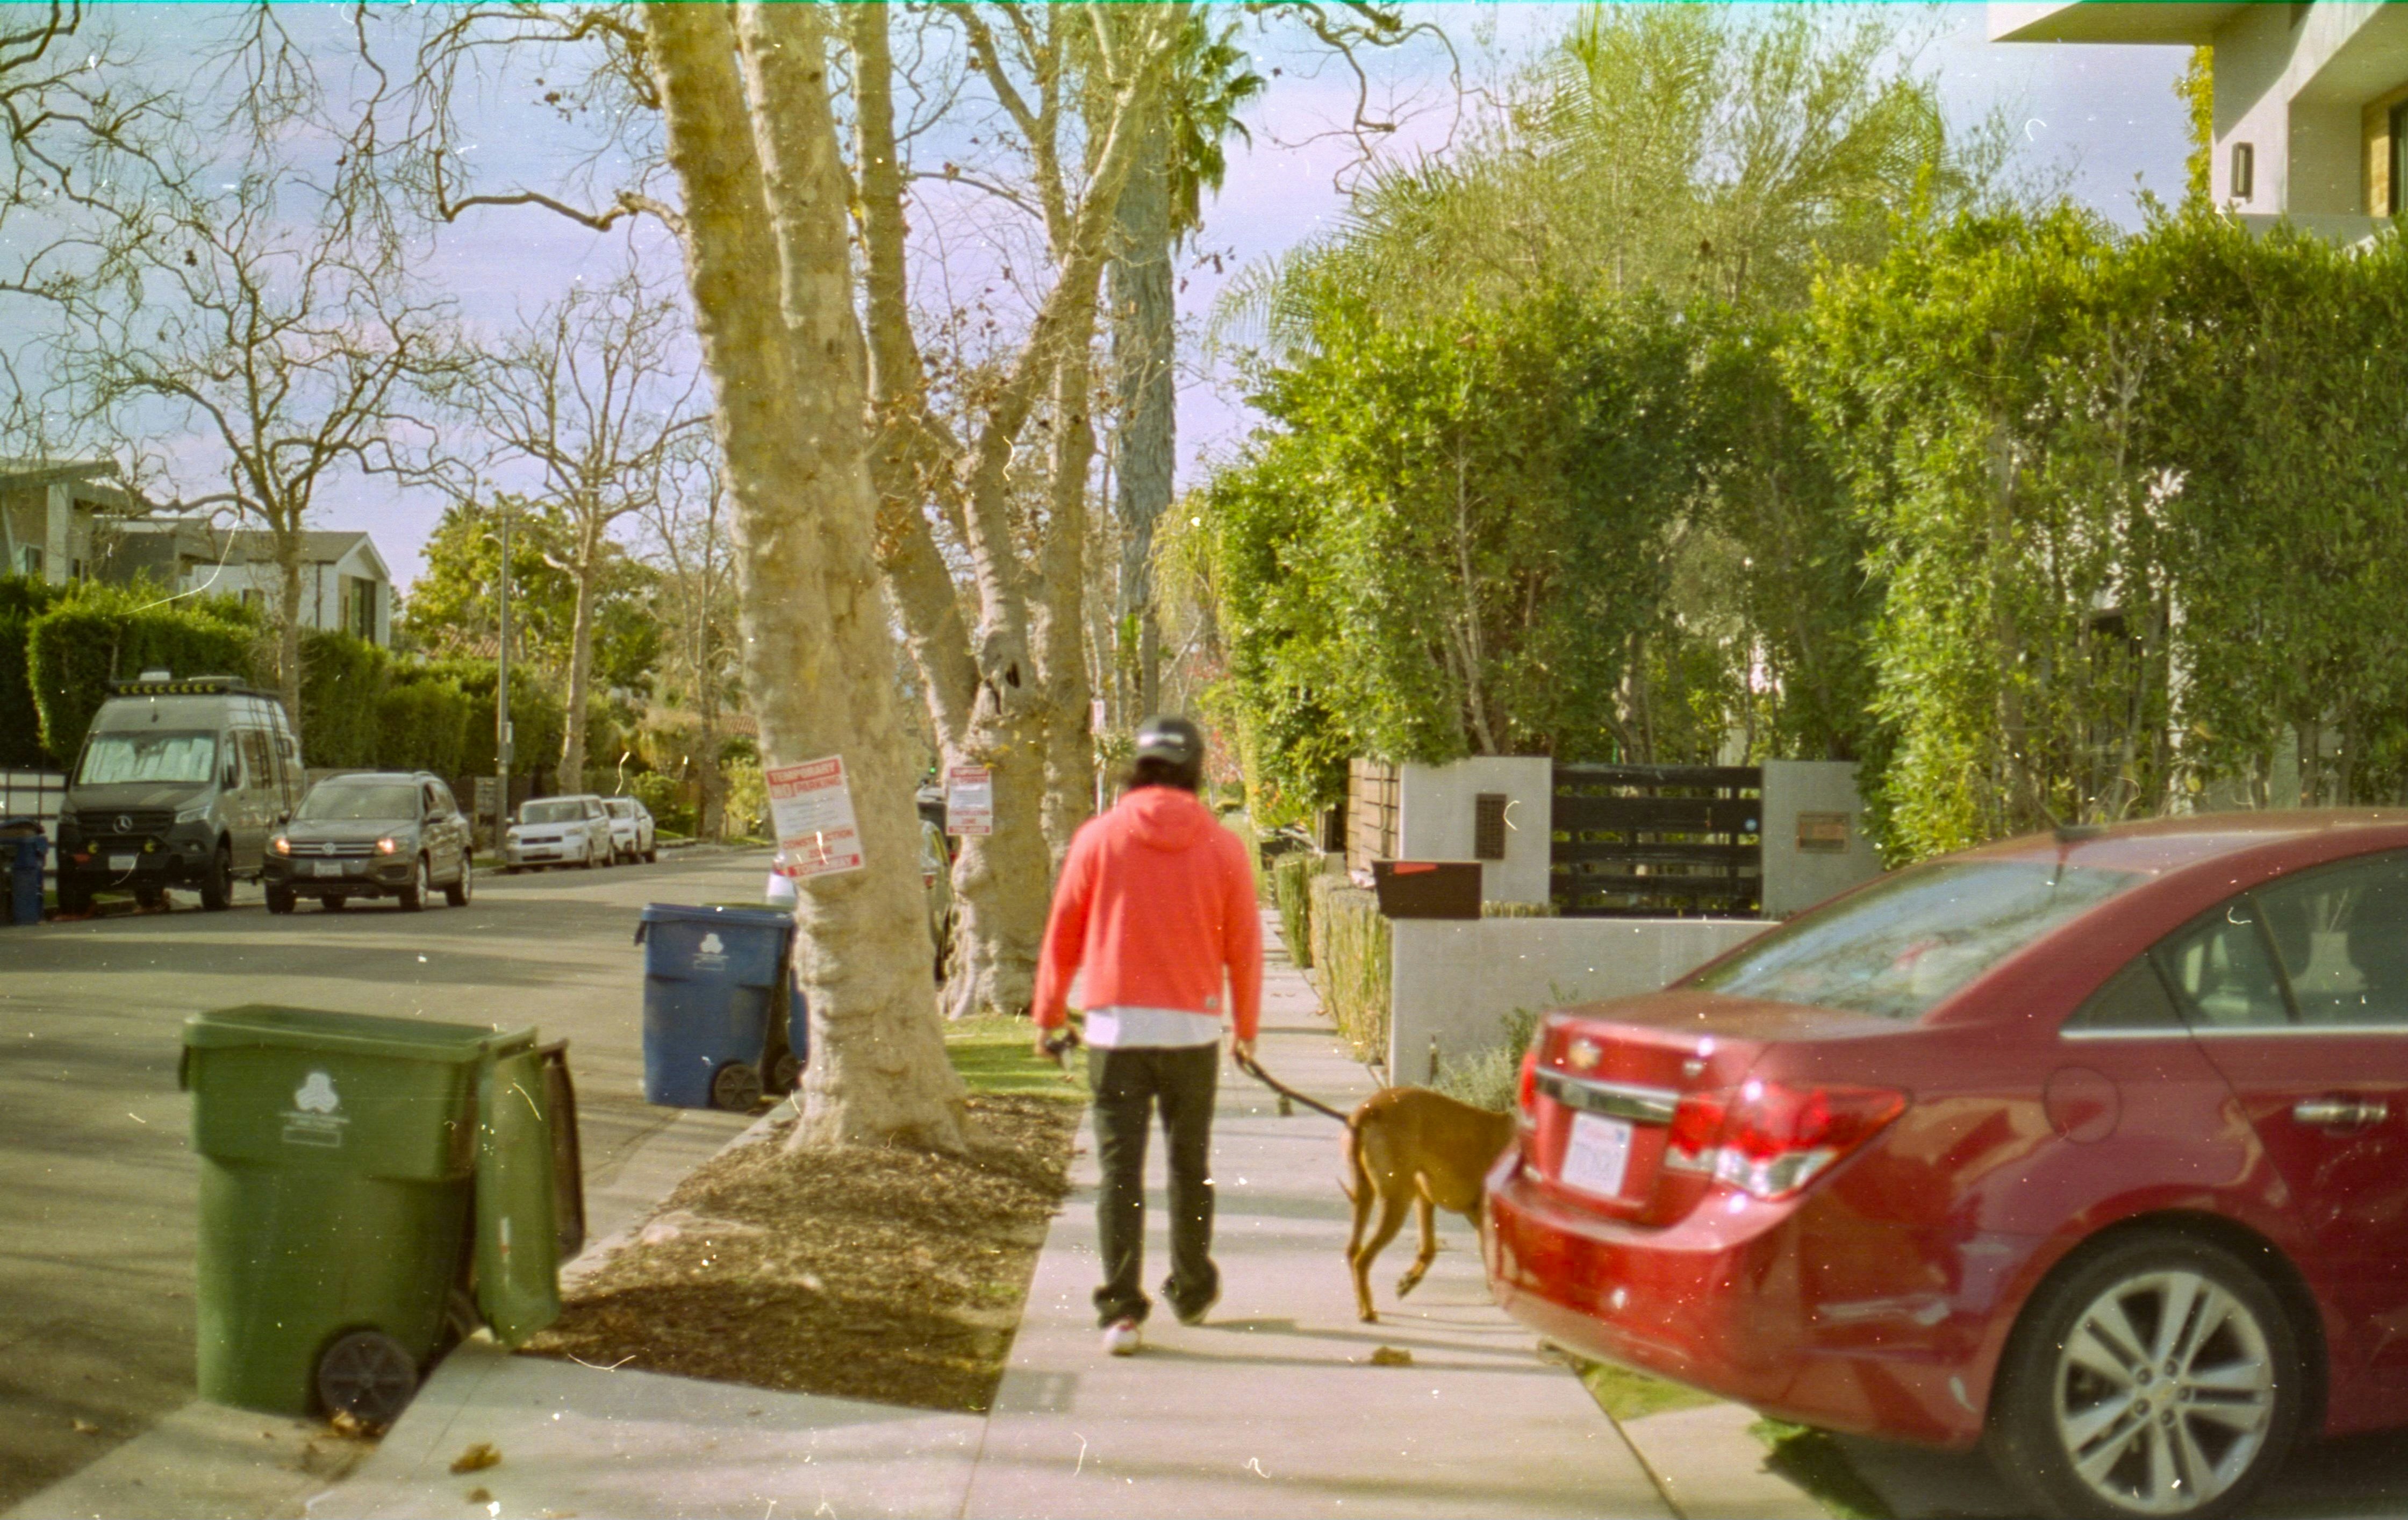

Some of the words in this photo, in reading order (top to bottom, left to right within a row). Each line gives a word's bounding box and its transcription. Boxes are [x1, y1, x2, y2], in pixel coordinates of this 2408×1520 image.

[771, 761, 836, 783] TEMPORARY
[772, 784, 792, 798] NO
[796, 776, 842, 792] PARKING
